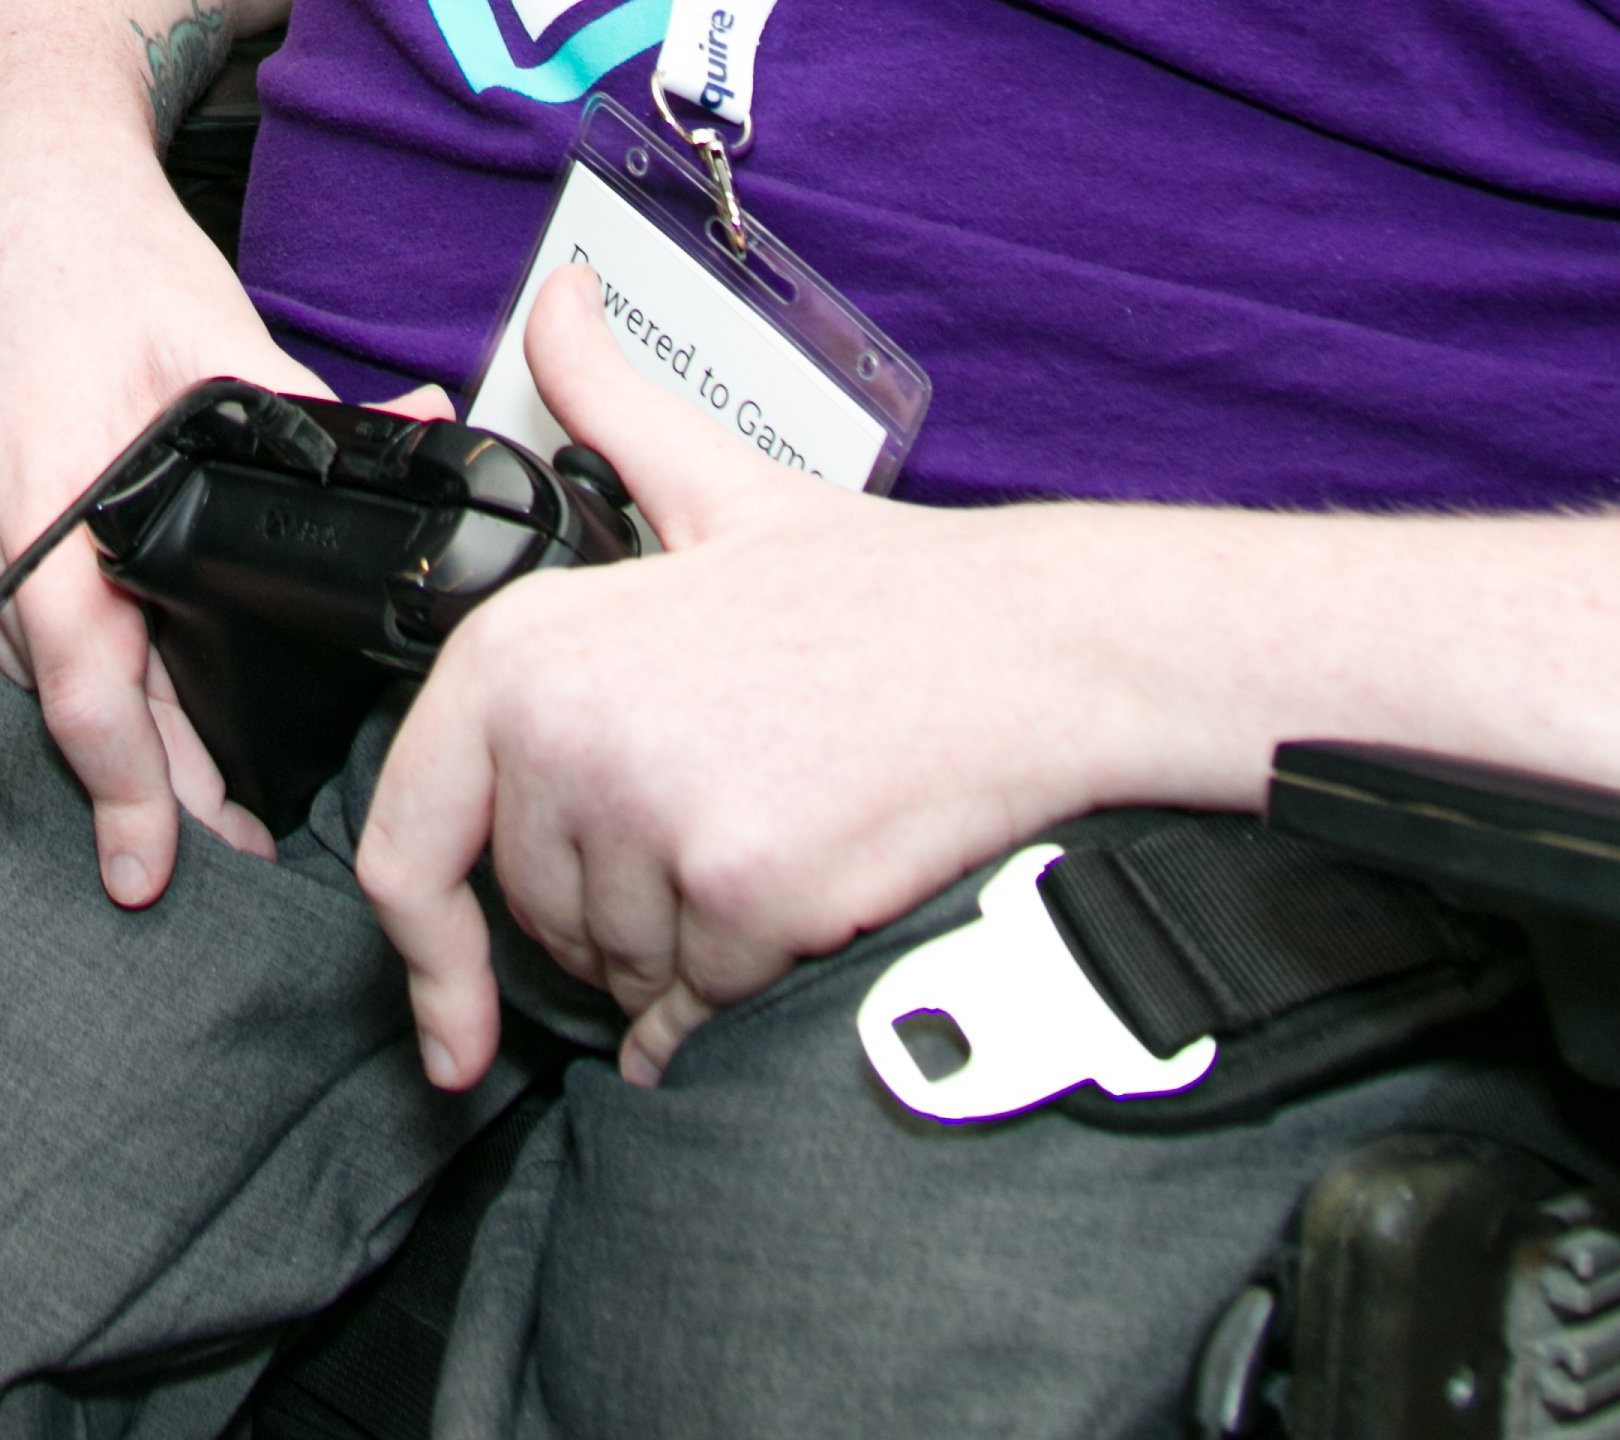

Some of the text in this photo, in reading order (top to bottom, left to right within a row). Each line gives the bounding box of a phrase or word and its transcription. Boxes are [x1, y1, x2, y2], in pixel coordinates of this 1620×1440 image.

[700, 7, 735, 111] quire
[570, 243, 825, 480] Pwered to Gam
